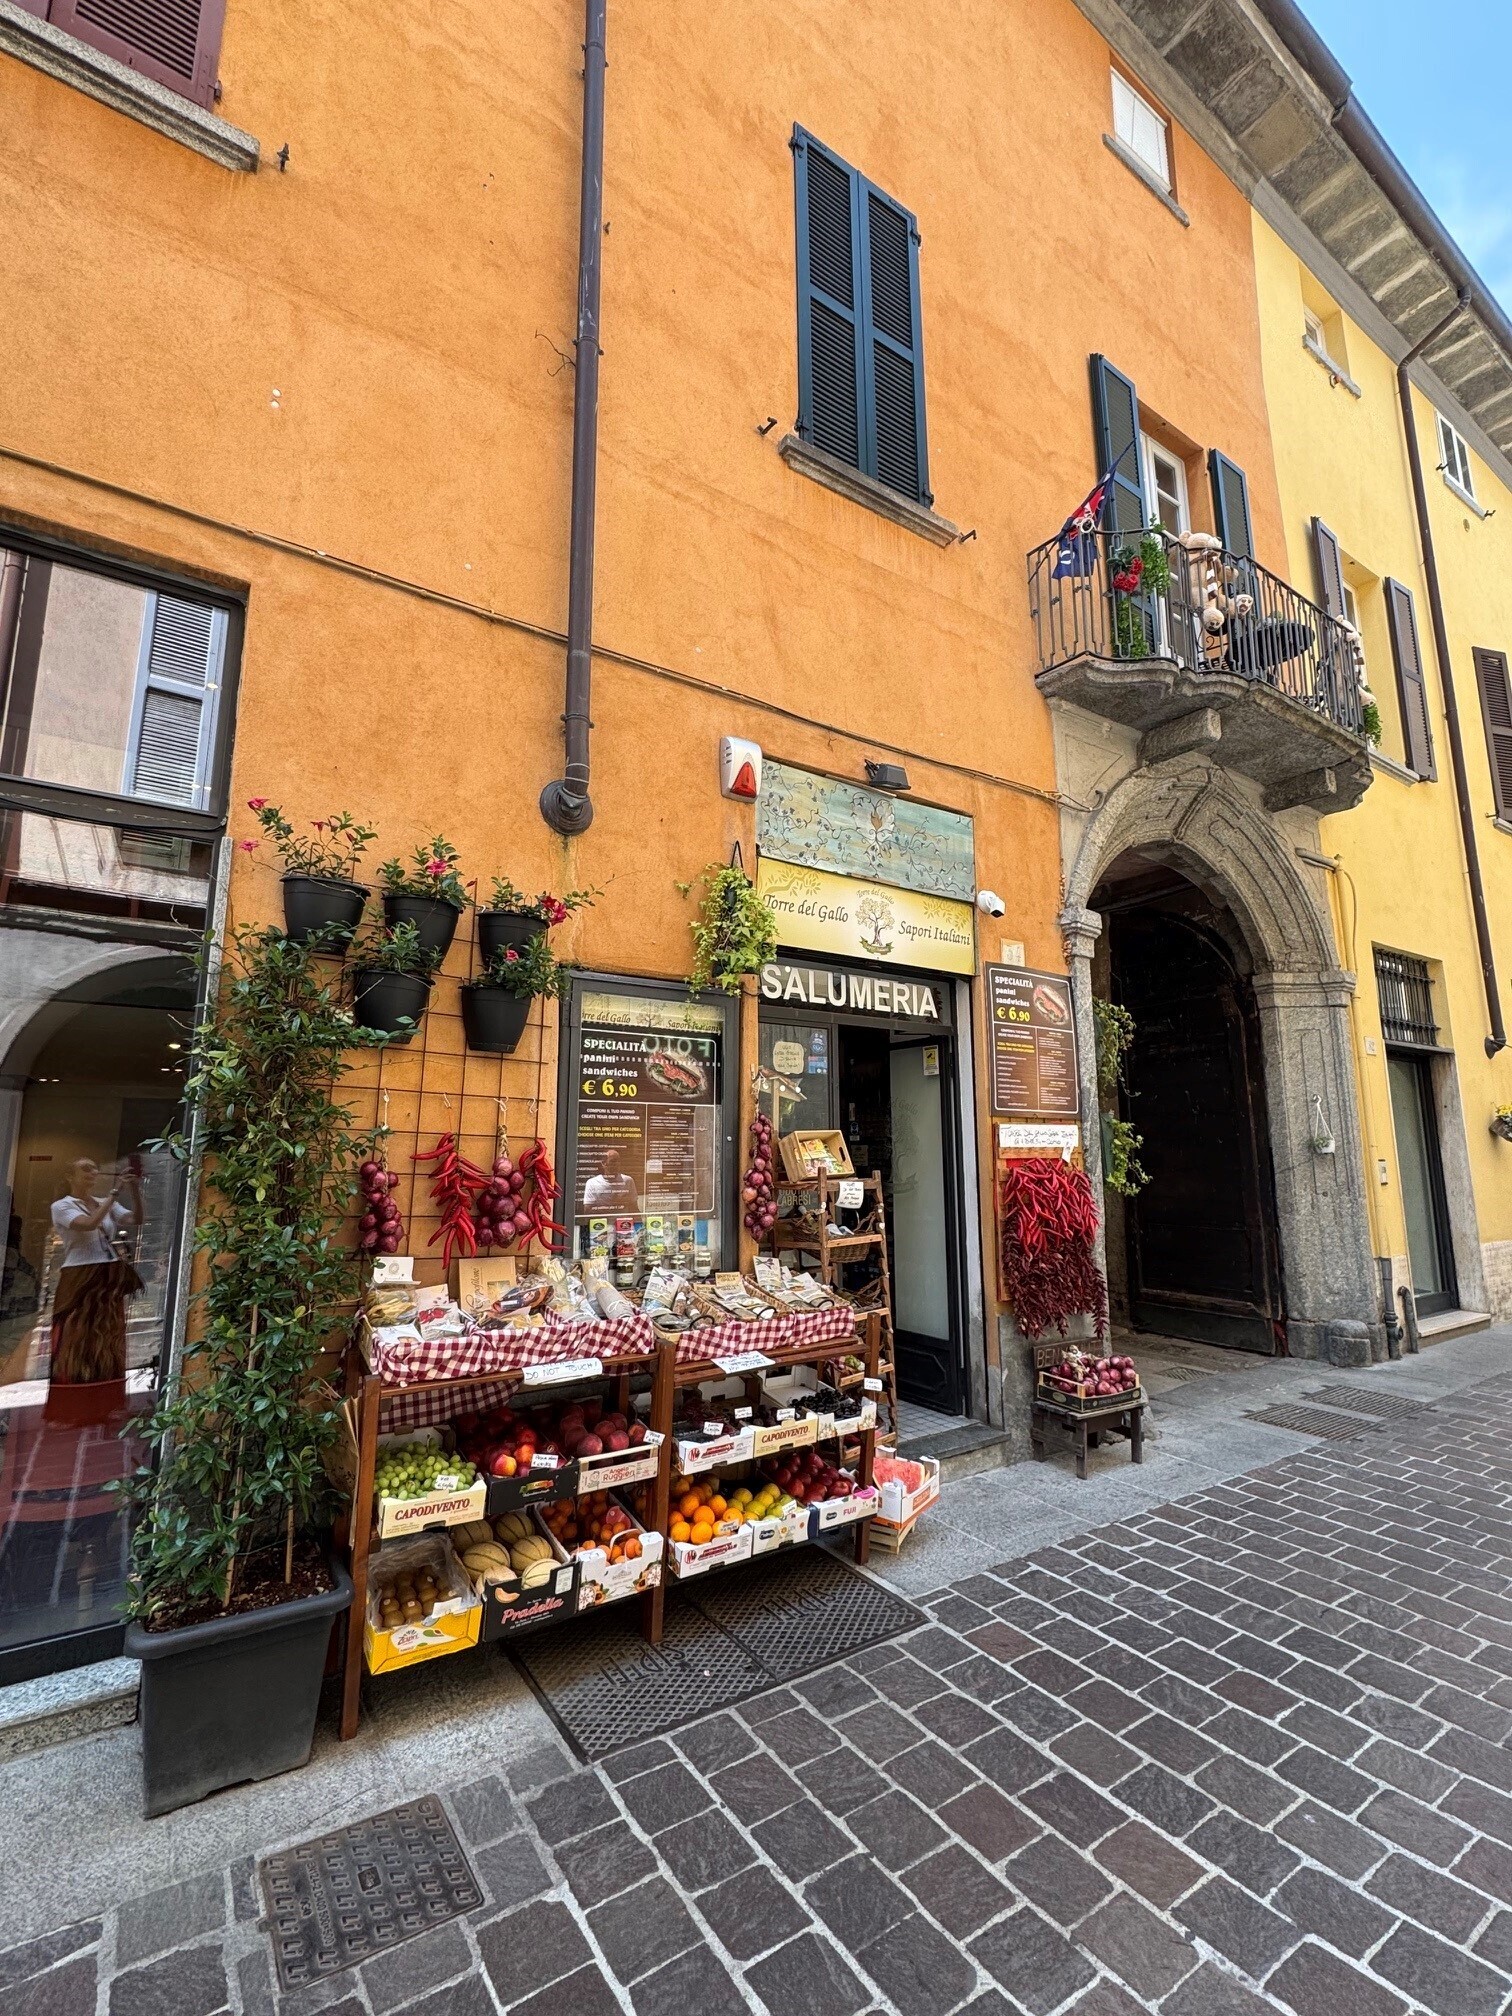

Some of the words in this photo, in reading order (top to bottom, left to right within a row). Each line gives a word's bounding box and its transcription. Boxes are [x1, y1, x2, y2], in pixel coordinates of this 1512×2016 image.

[763, 893, 795, 913] Torre
[797, 899, 815, 917] del
[818, 905, 849, 923] Gallo
[898, 920, 932, 942] Sapori
[933, 926, 971, 946] Italiani
[994, 975, 1034, 989] SPECIALITÀ
[761, 964, 939, 1019] SALUMERIA
[995, 987, 1016, 996] panini
[996, 997, 1030, 1007] sandwiches
[609, 1013, 631, 1023] Gallo
[996, 1006, 1006, 1019] €
[583, 1038, 647, 1053] SPECIALITÀ
[582, 1054, 616, 1063] panini
[582, 1066, 638, 1078] sandwiches
[582, 1079, 596, 1096] €
[601, 1078, 638, 1098] 6,90
[525, 1371, 539, 1381] DO
[543, 1366, 560, 1377] NOT
[761, 1425, 809, 1444] CAPODIVENTO
[395, 1497, 470, 1521] CAPODIVENTO
[843, 1506, 857, 1516] FUJI
[501, 1596, 565, 1624] Pradella
